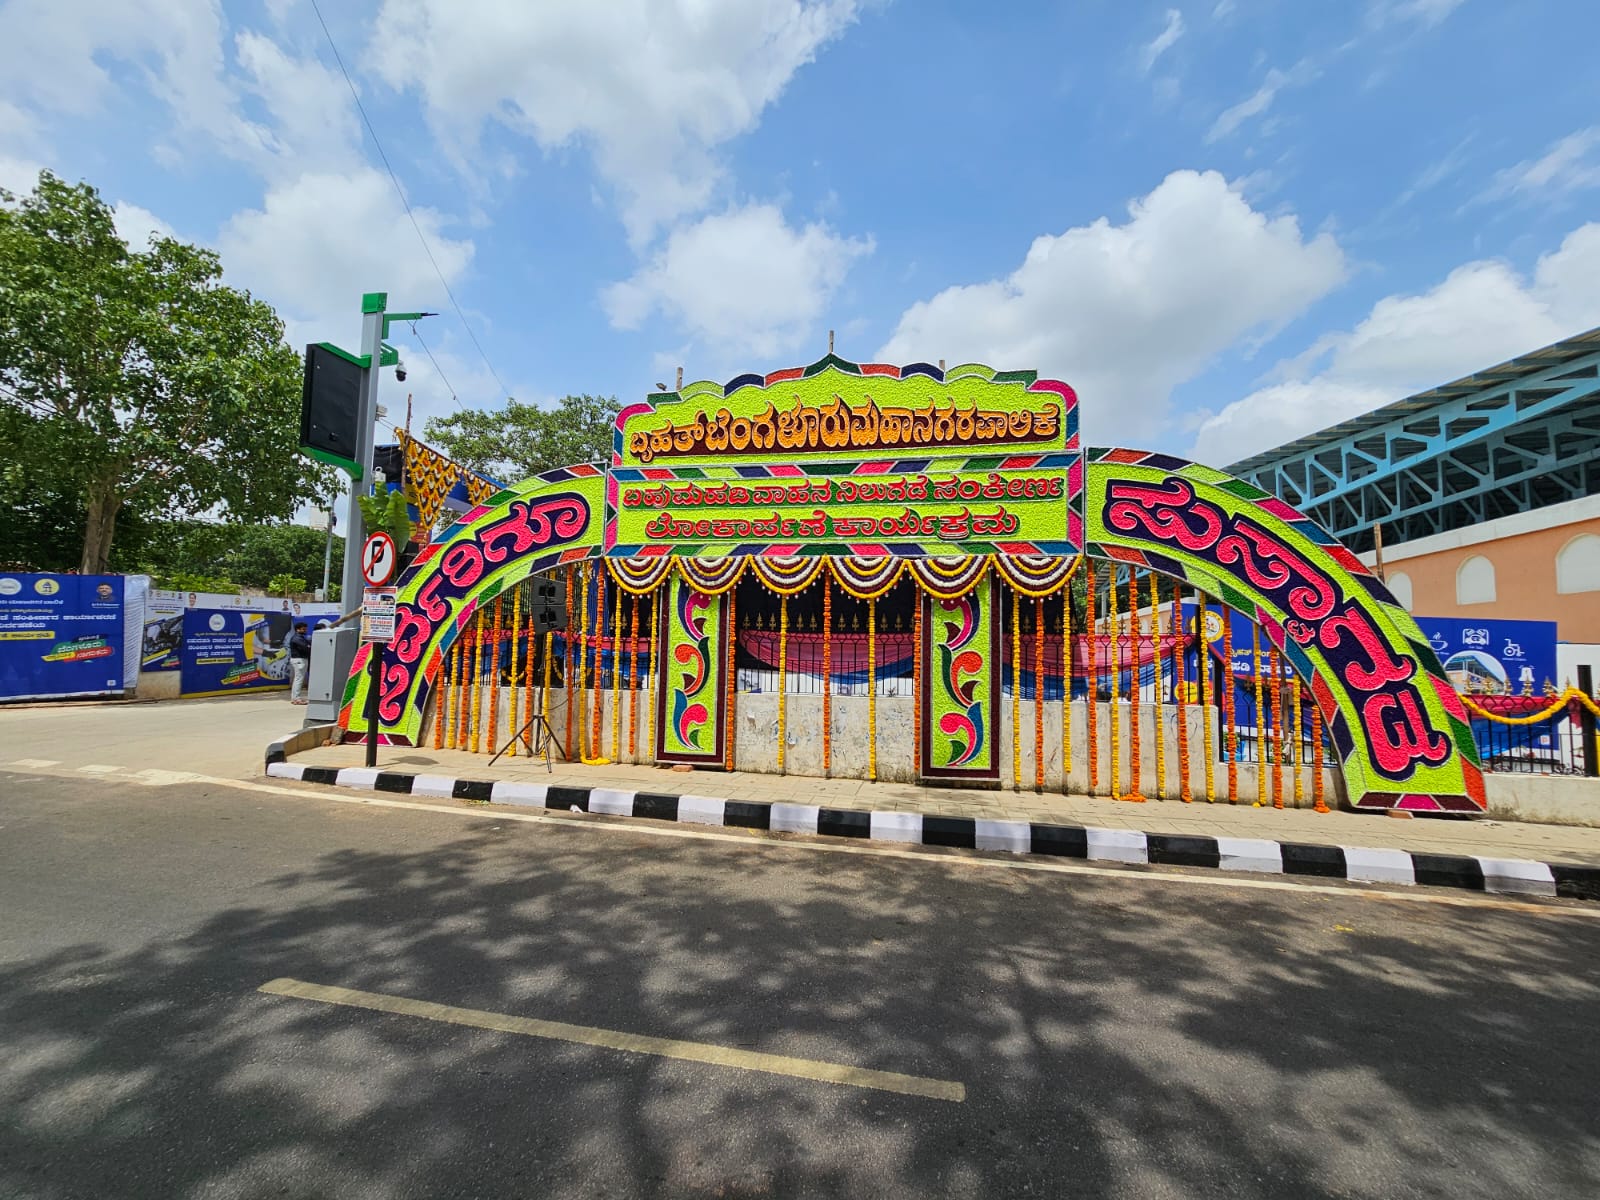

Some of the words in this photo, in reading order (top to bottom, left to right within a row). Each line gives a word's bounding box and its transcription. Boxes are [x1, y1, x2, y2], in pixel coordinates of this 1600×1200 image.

[836, 474, 929, 502] ನಿಲುಗಡೆ
[933, 473, 1062, 500] ಸಂಕೀರ್ಣ
[645, 508, 828, 538] ಲೋಕಾರ್ಪಣೆ
[831, 504, 1019, 540] ಕಾರ್ಯಕ್ರಮ
[1108, 480, 1449, 773] ಸುಸ್ವಾಗತ
